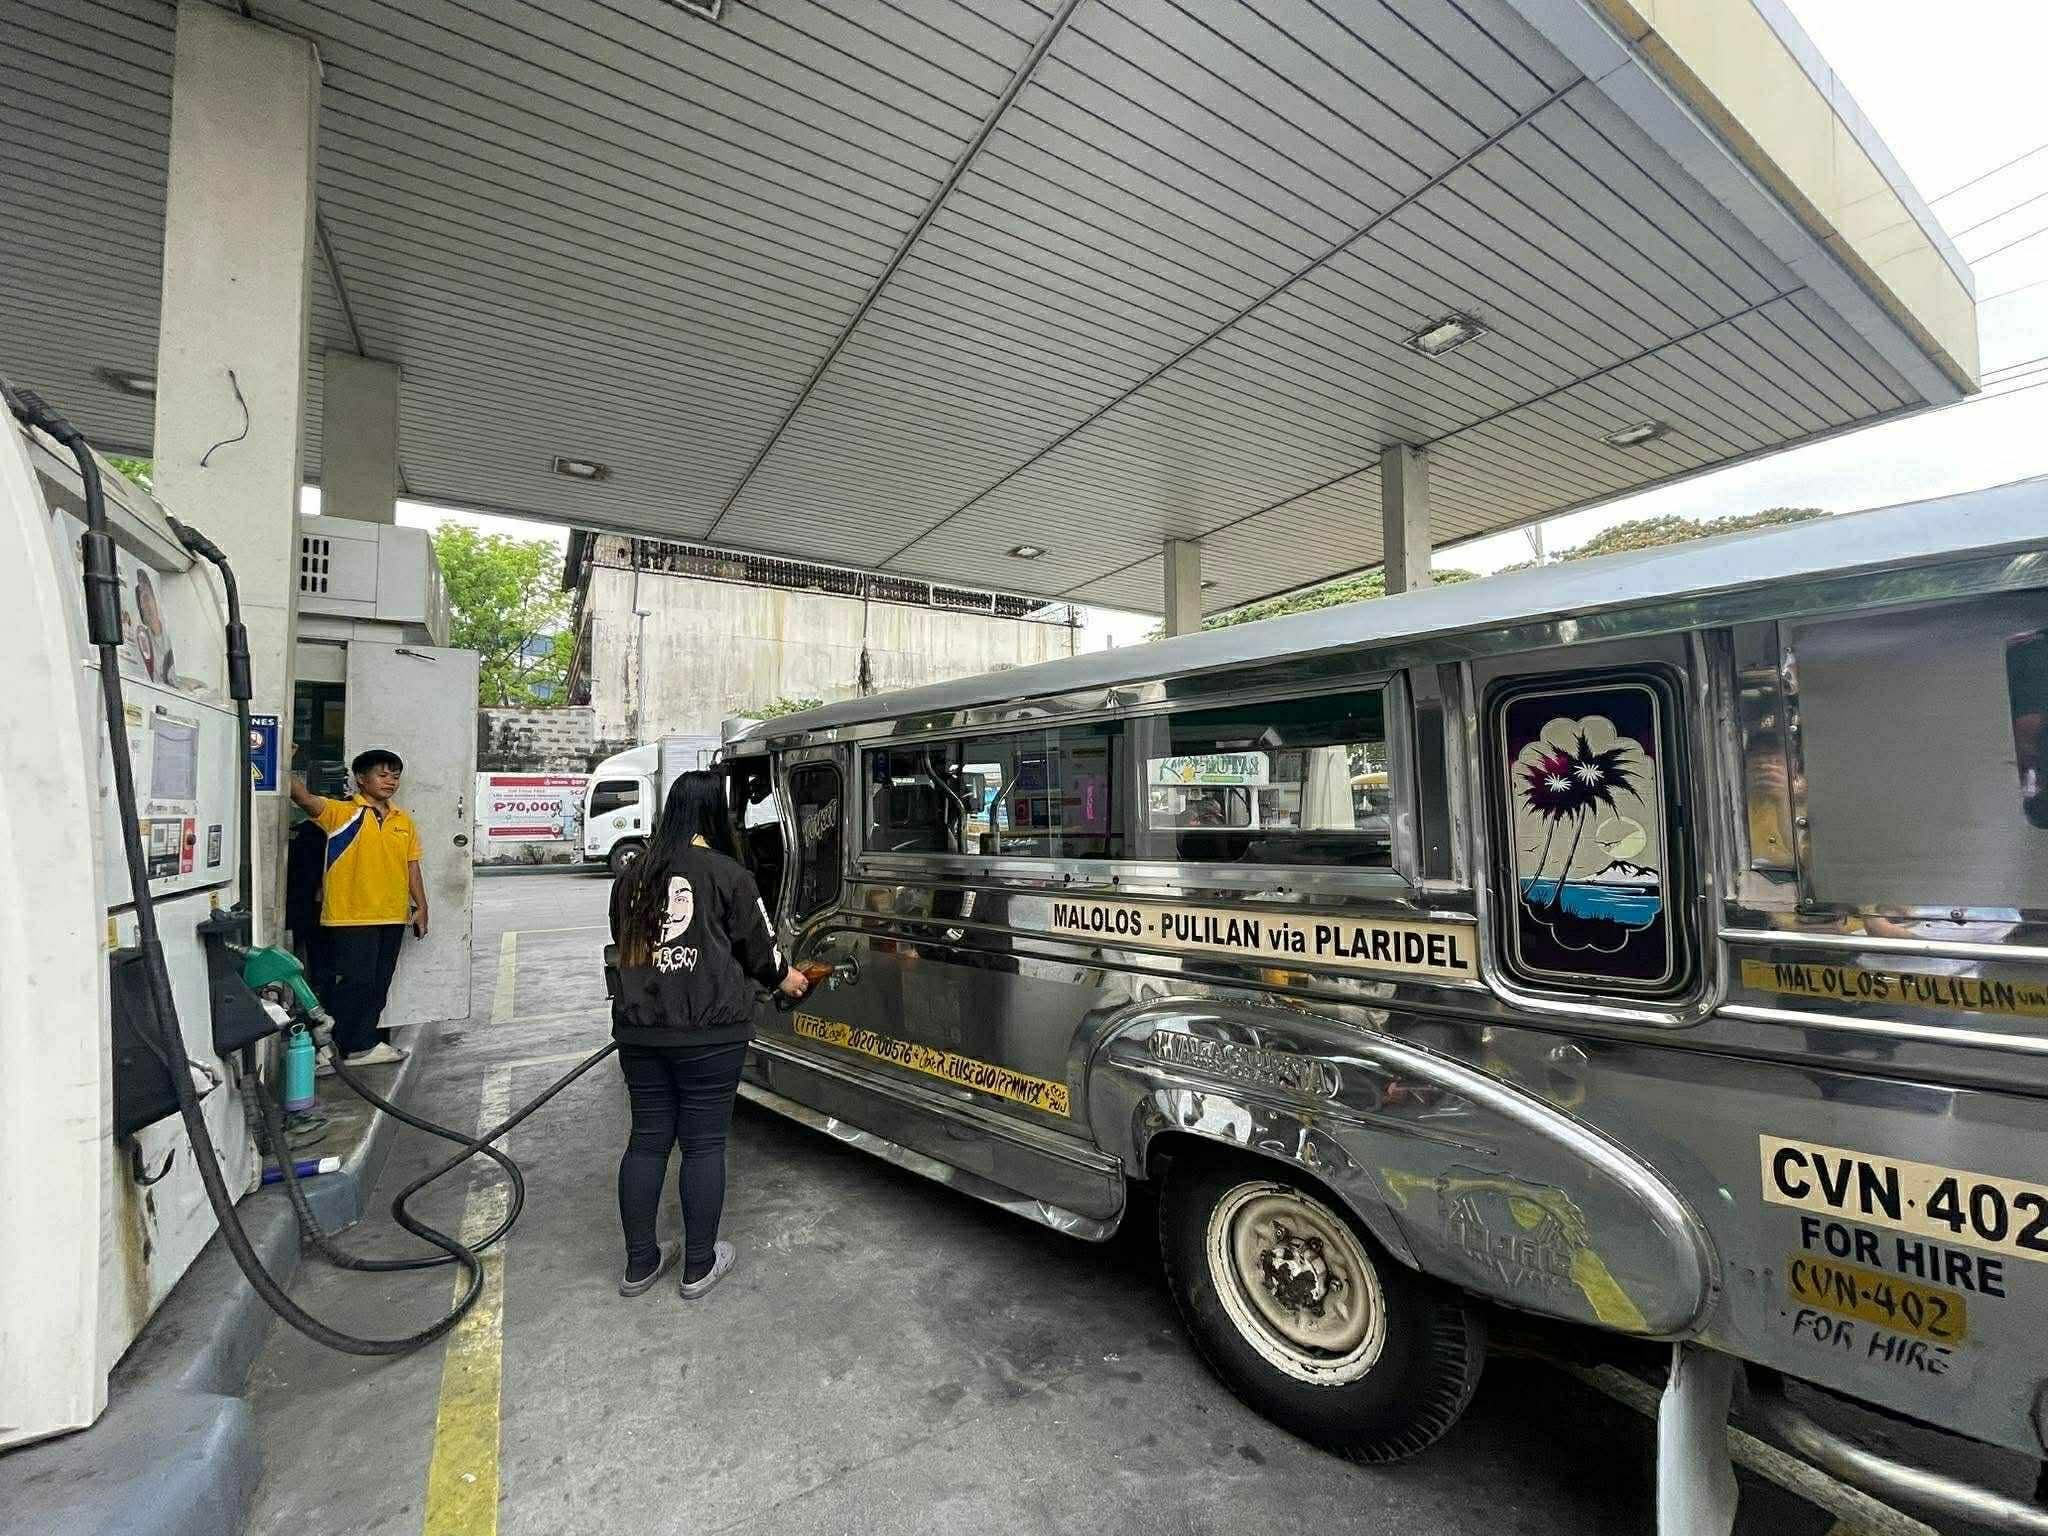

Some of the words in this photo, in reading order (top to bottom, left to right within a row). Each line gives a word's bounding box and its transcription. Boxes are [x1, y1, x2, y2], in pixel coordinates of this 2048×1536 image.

[1054, 903, 1142, 936] MALOLOS
[1161, 912, 1260, 948] PULILAN
[1269, 922, 1306, 953] via
[1315, 924, 1469, 970] PLARIDEL
[1774, 963, 1890, 999] MALOLOS
[1900, 973, 2016, 1011] PULILAN
[1800, 1215, 1883, 1268] FOR
[1896, 1237, 2006, 1299] HIRE
[1793, 1308, 1856, 1350] FOR
[1867, 1330, 1953, 1376] HIRE
